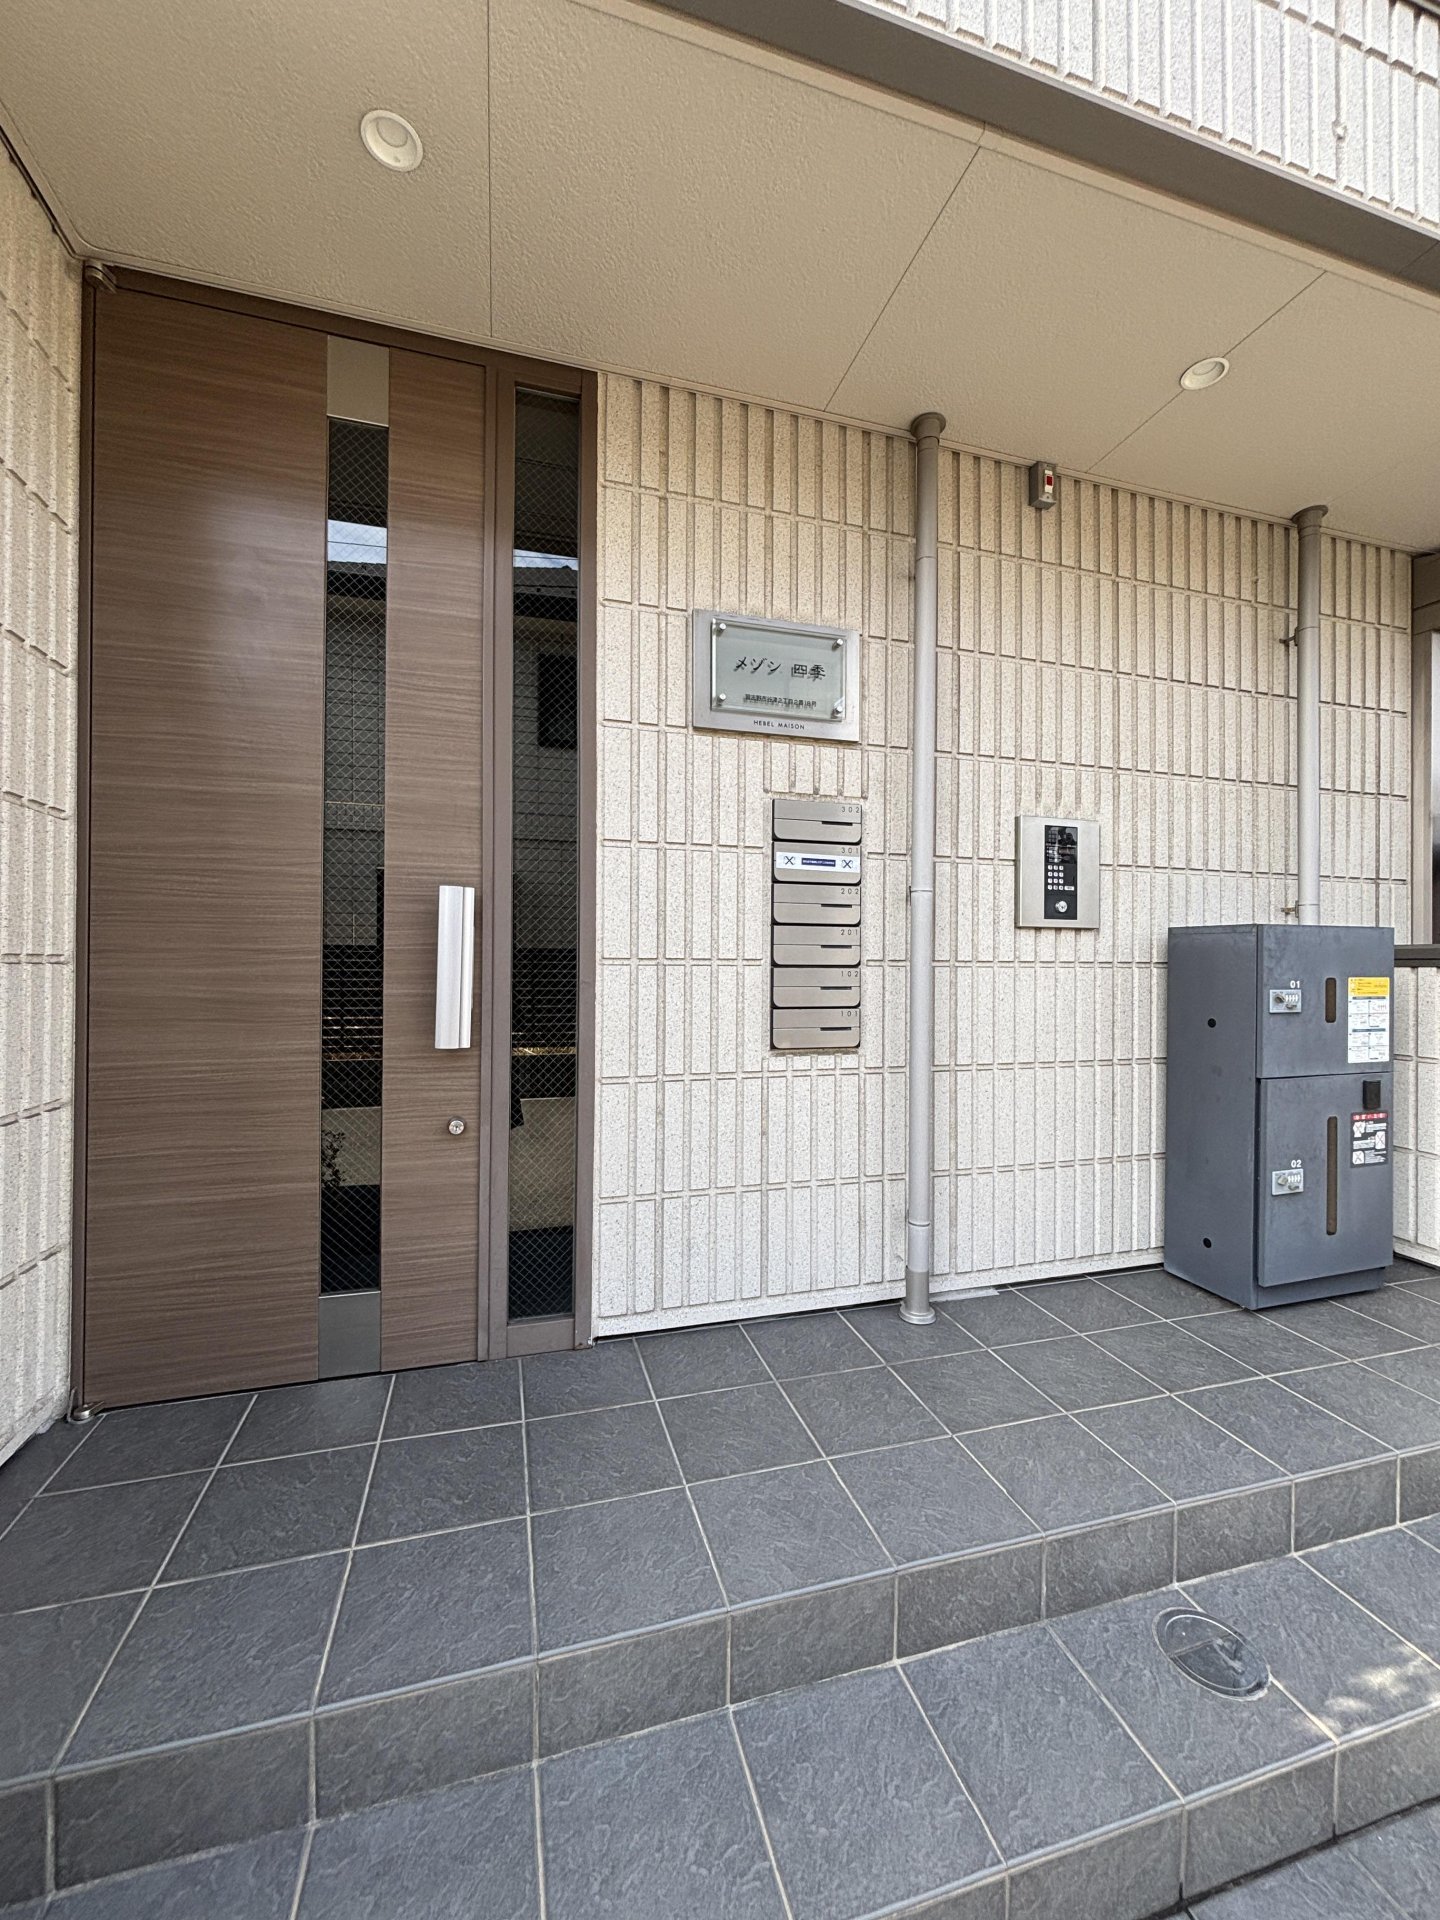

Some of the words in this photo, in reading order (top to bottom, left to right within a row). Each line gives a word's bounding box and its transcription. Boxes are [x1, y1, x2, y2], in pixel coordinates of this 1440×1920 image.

[735, 656, 782, 672] メゾン
[793, 663, 826, 680] 四季
[753, 719, 774, 727] HEBEL
[778, 722, 805, 730] MAISON
[841, 806, 860, 814] 302
[840, 887, 859, 895] 202
[841, 970, 859, 978] 102
[1289, 980, 1301, 989] 01
[1290, 1159, 1302, 1168] 02
